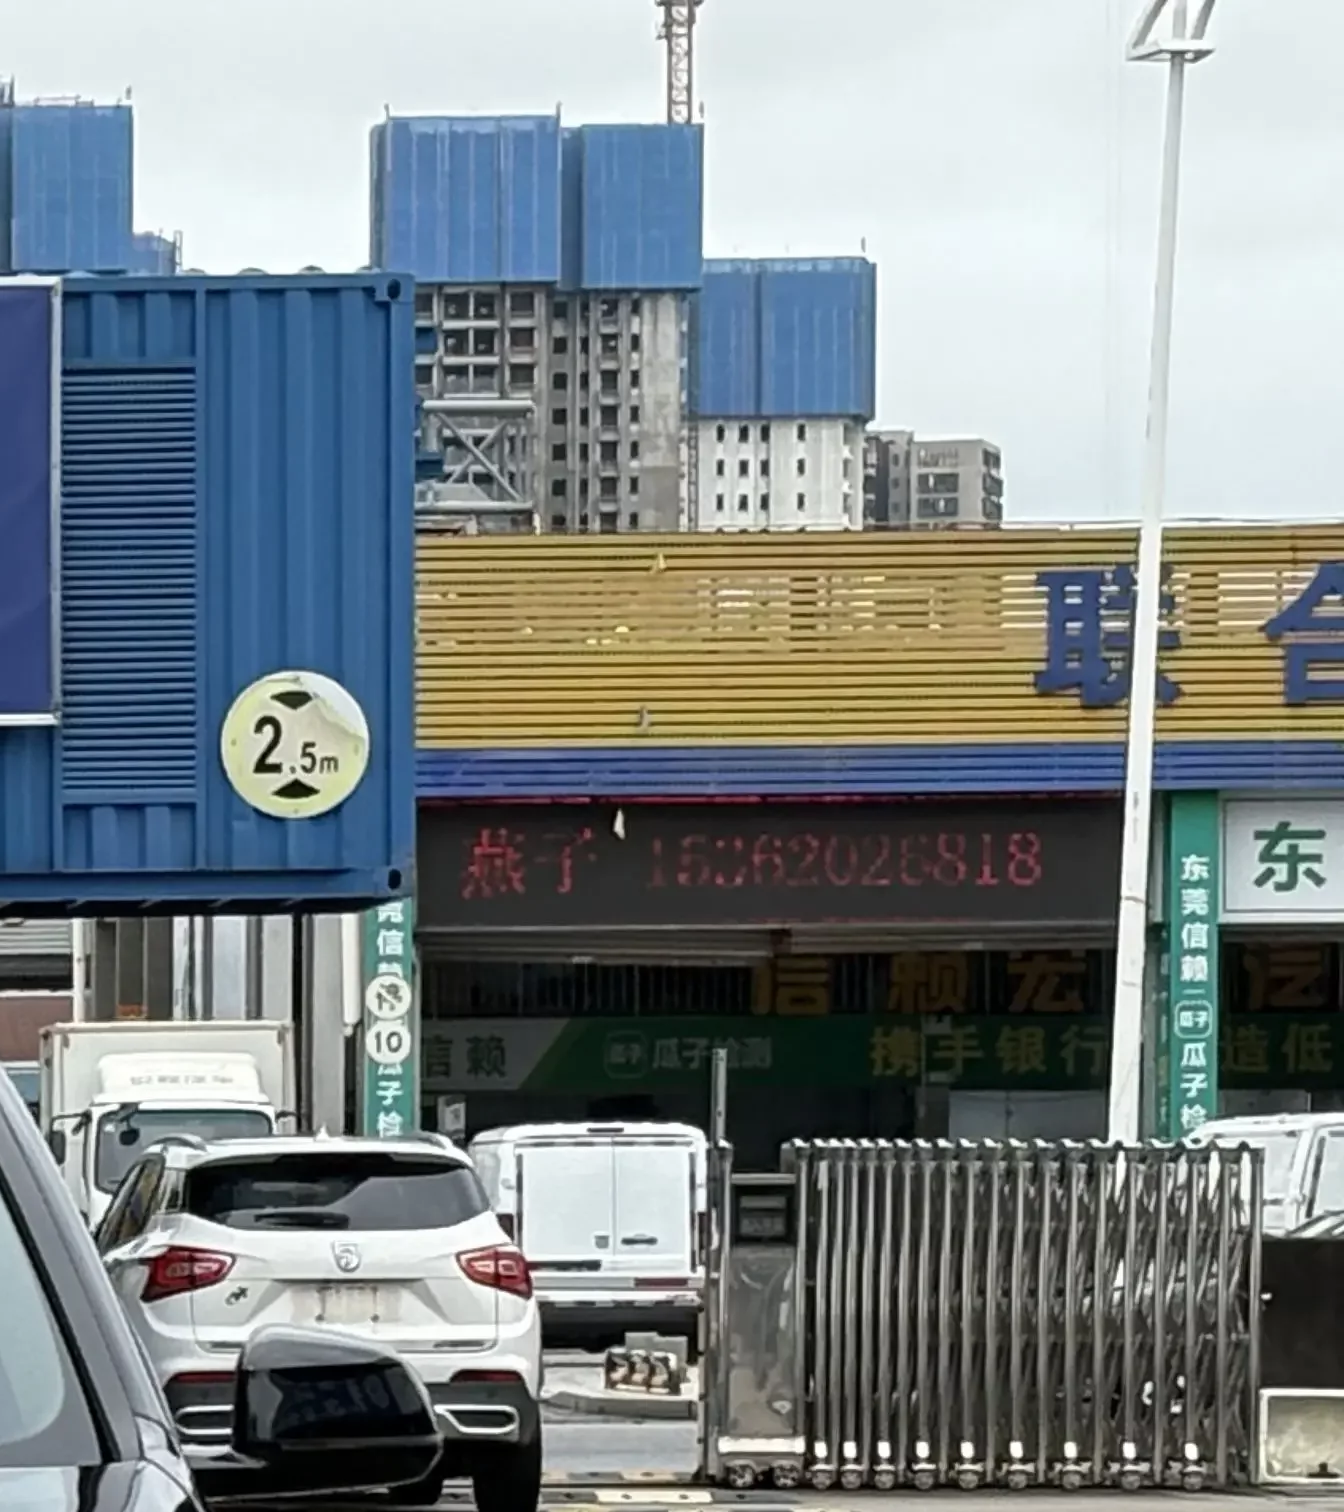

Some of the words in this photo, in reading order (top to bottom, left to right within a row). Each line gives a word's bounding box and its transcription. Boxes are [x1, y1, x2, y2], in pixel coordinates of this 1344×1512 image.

[252, 715, 339, 775] 2.5m
[1253, 820, 1326, 893] 东
[374, 1030, 403, 1055] 10
